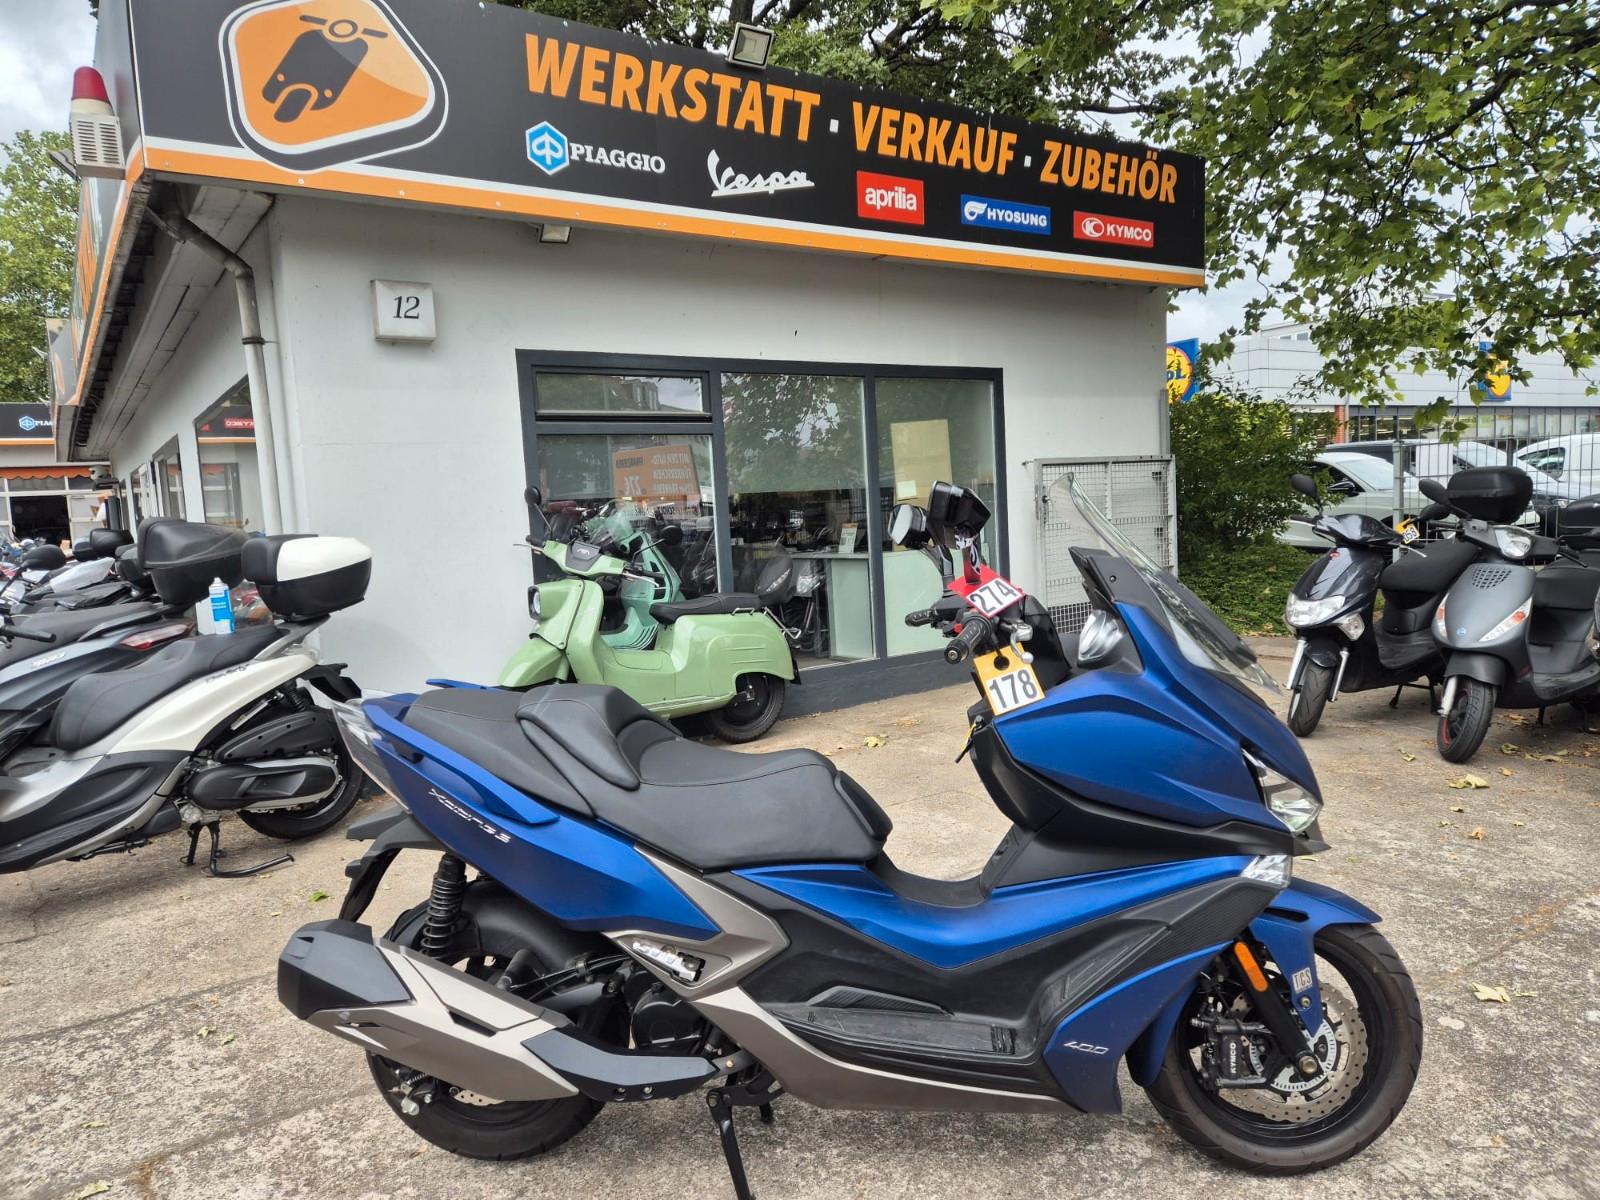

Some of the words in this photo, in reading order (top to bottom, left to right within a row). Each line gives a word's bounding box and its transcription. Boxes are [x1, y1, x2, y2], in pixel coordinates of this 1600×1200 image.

[525, 33, 821, 141] WERKSTATT
[852, 101, 1017, 175] VERKAUF
[1039, 140, 1178, 203] ZUBEHÖR
[569, 142, 666, 173] PIAGGIO
[707, 149, 815, 197] Vespa
[865, 185, 917, 211] aprilia
[987, 207, 1047, 227] HYOSUNG
[1106, 223, 1152, 240] KYMCO
[393, 295, 420, 319] 12
[969, 580, 1018, 614] 274
[989, 669, 1037, 709] 178
[1294, 969, 1312, 988] TCS
[1063, 1041, 1110, 1055] 400
